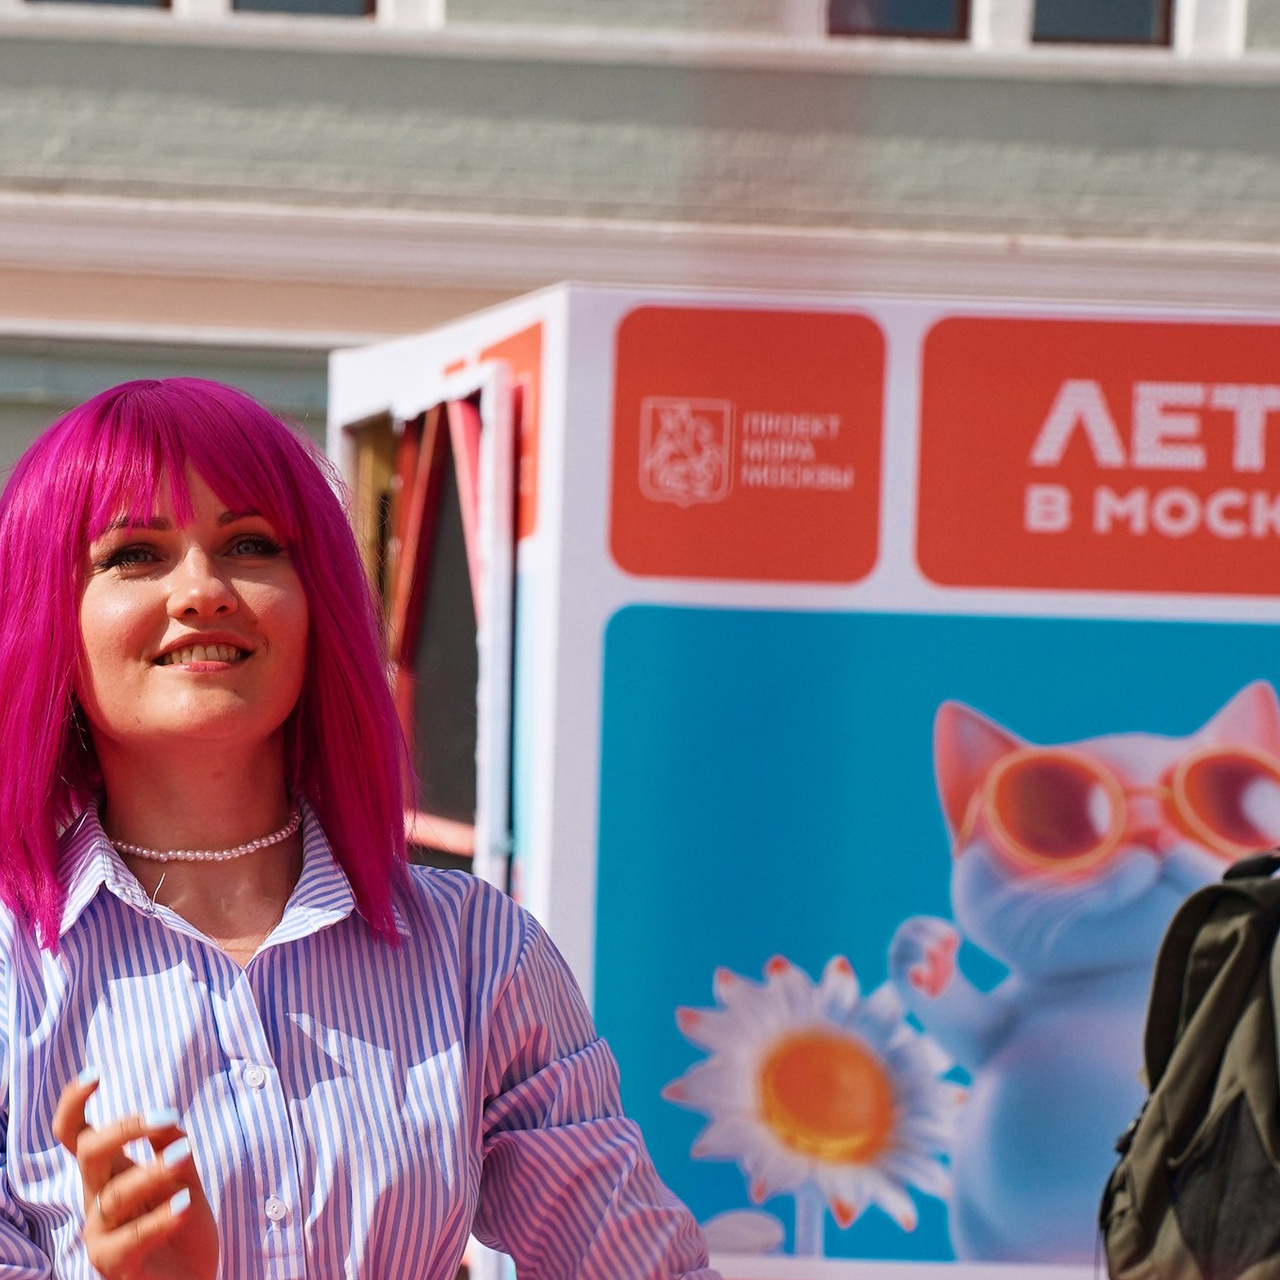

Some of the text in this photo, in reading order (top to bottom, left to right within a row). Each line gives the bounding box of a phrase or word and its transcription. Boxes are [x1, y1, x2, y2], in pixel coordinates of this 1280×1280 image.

[1029, 378, 1280, 471] ЛЕТ
[740, 463, 855, 491] МОСКВЫ
[1024, 483, 1073, 534] В
